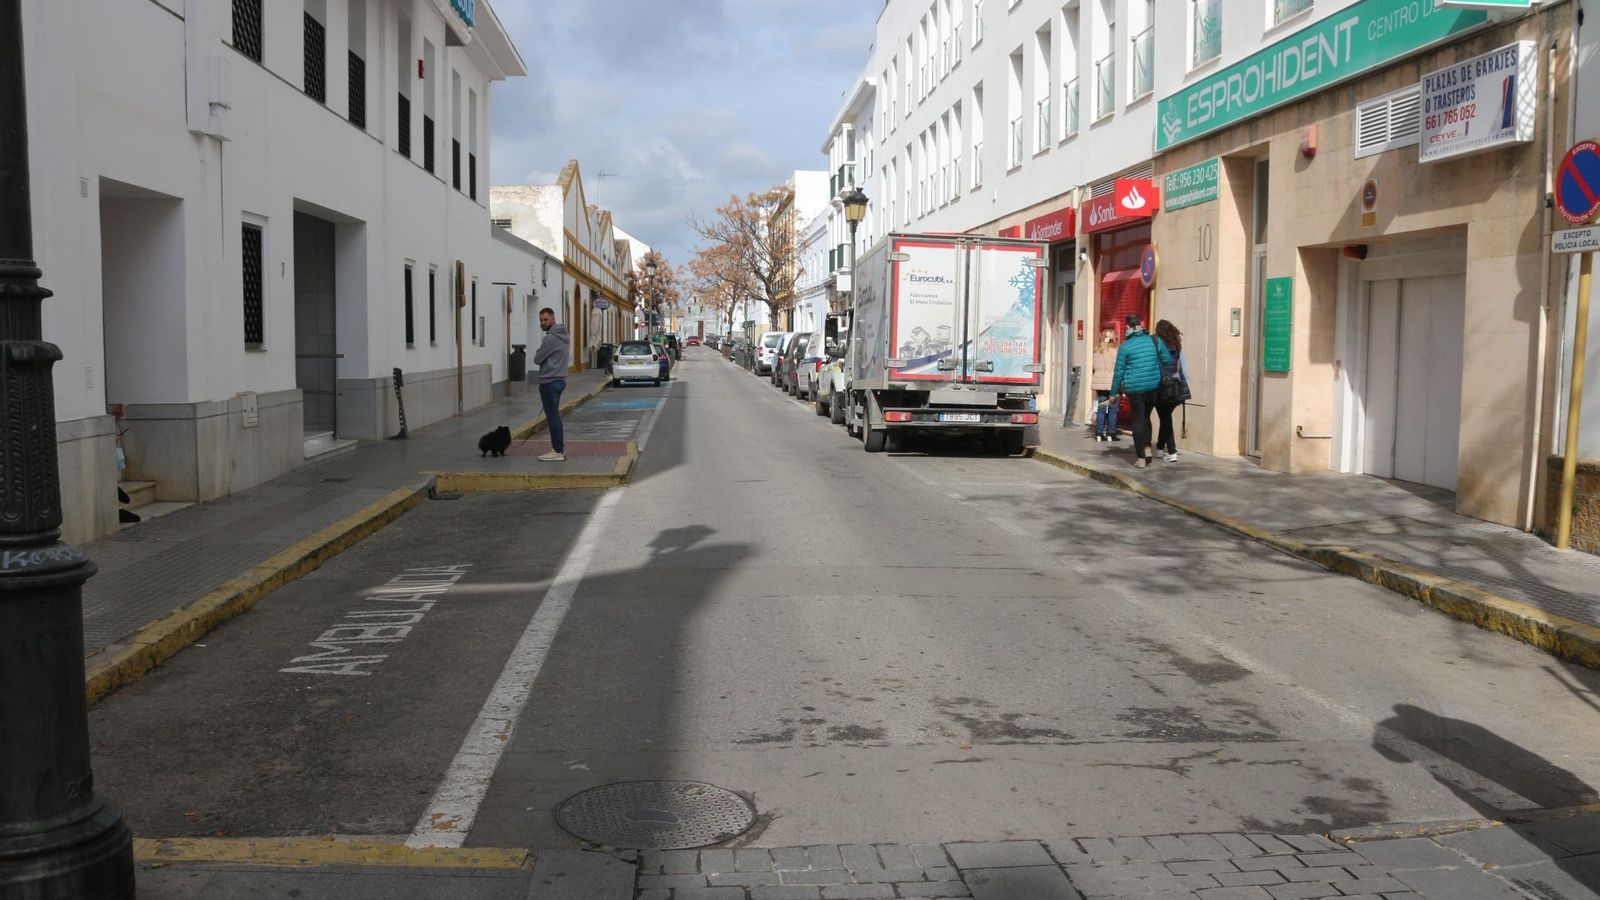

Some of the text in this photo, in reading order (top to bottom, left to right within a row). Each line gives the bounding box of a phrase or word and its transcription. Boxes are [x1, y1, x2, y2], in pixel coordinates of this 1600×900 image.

[1187, 16, 1359, 128] ESPROHIDENT
[1367, 1, 1419, 41] CENTRO
[1425, 49, 1517, 94] PLAZAS DE GARAJES
[1425, 84, 1476, 113] O TRASTEROS
[1425, 103, 1476, 130] 661 765 052
[1197, 223, 1212, 262] 10
[1563, 229, 1592, 240] EXCEPTO
[1579, 239, 1599, 248] LOCAL
[278, 563, 474, 676] AMBULANCIA
